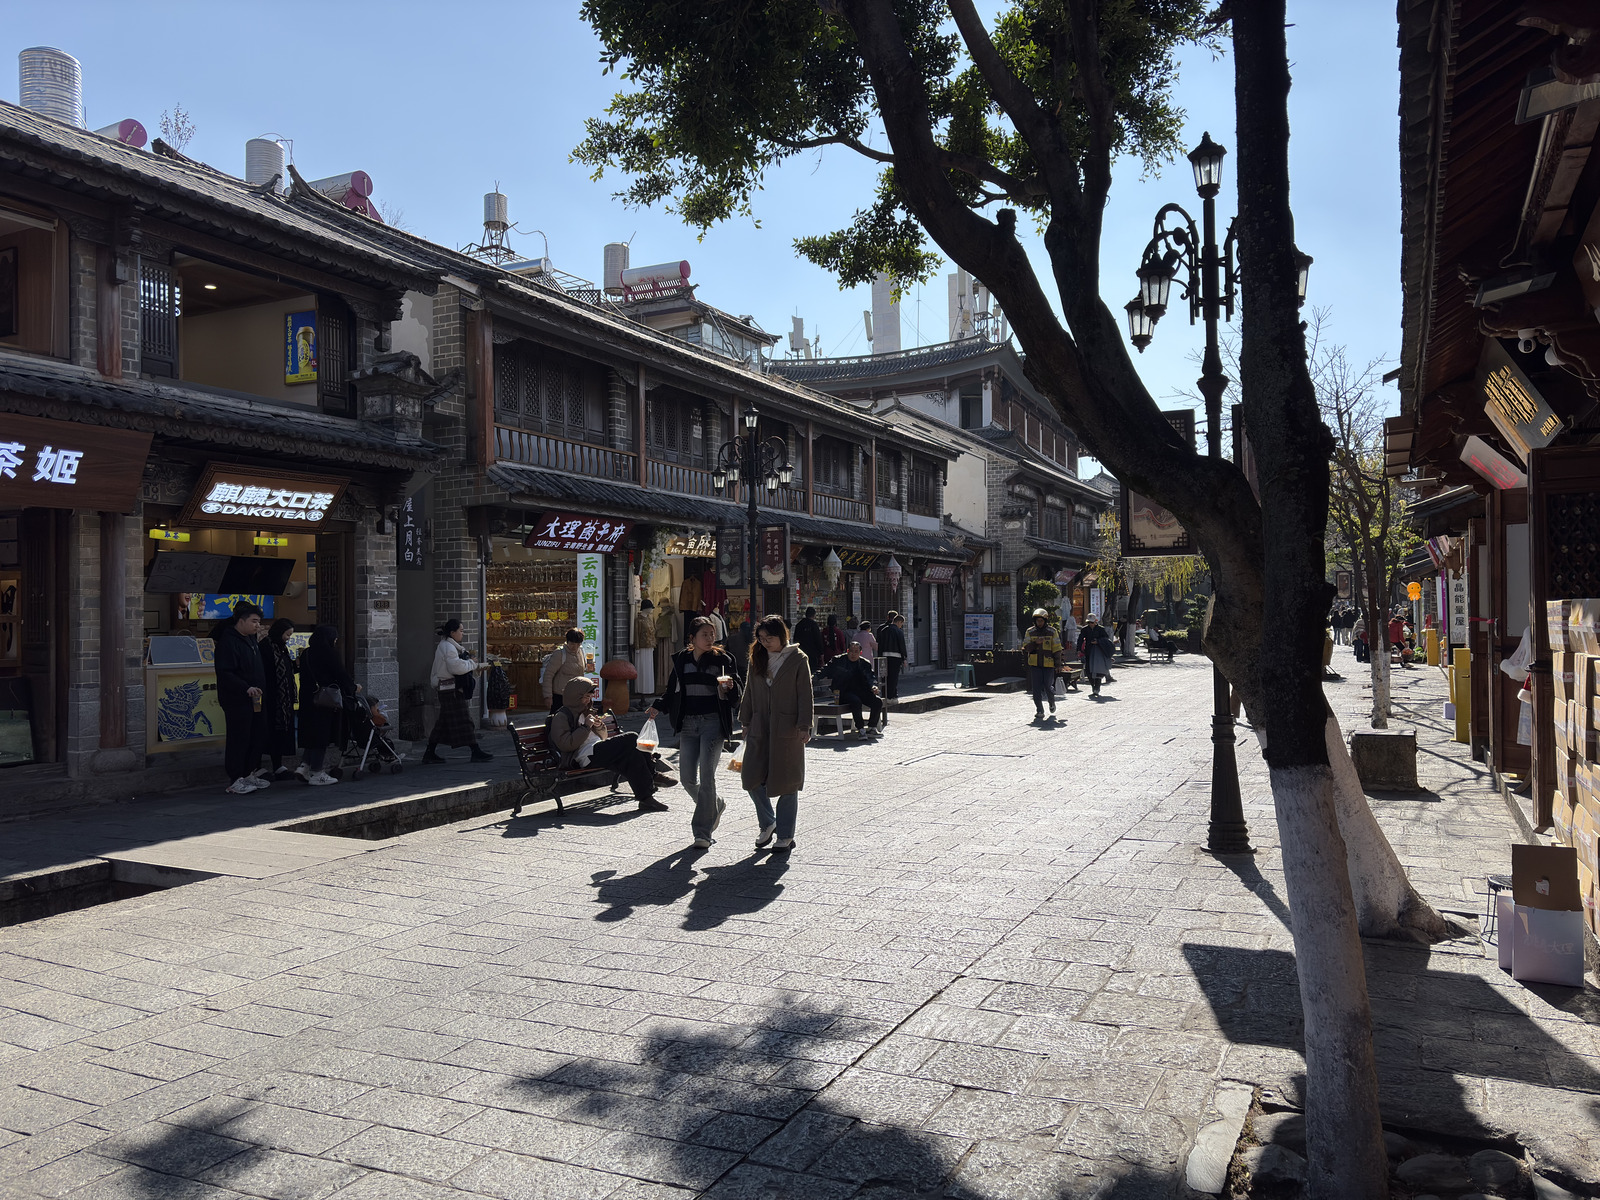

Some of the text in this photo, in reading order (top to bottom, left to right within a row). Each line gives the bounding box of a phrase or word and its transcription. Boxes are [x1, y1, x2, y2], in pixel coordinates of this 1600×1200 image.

[206, 481, 334, 511] 麒麟大口茶
[221, 504, 306, 520] DAKOTEA
[536, 516, 626, 544] 大理菌子府
[533, 539, 561, 548] JUNZIFU
